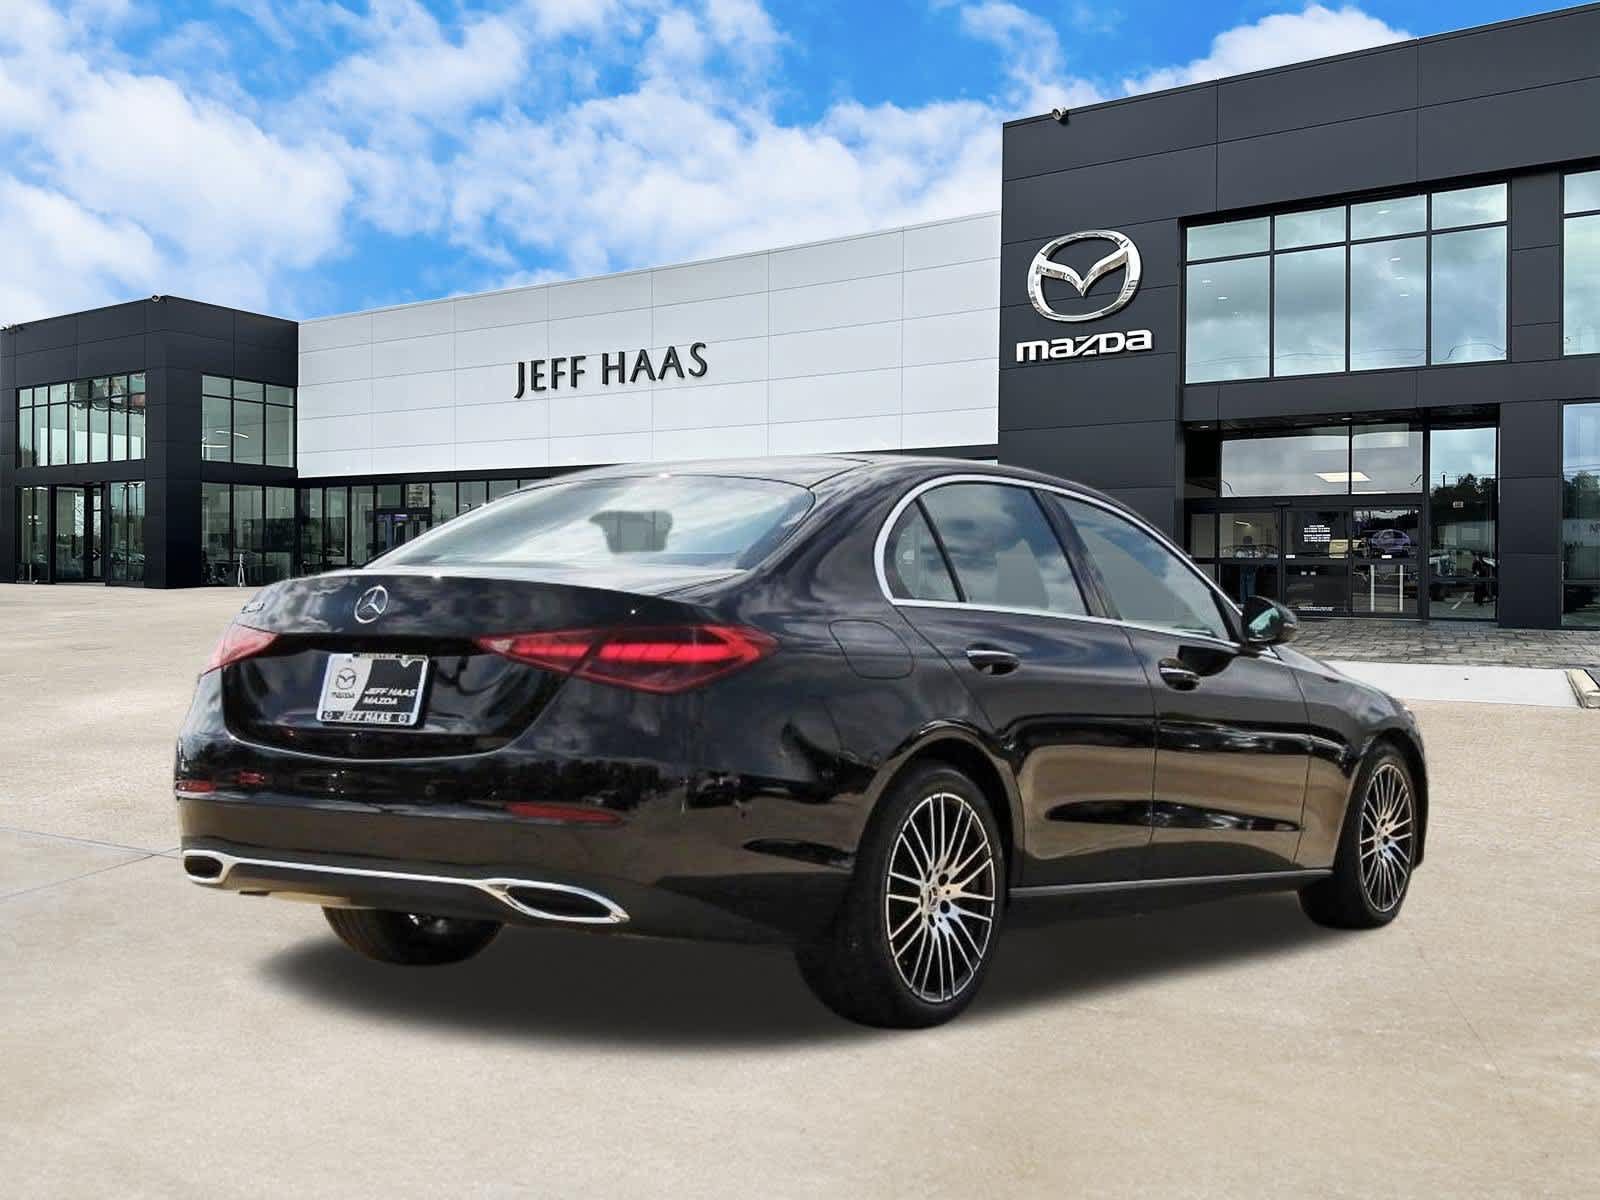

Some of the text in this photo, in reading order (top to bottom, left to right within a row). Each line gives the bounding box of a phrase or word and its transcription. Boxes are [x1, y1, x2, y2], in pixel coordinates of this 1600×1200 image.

[514, 342, 708, 399] JEFF HAAS
[388, 688, 417, 697] HAAS
[362, 696, 397, 704] MAZDA
[340, 711, 392, 722] JEFF HAAS
